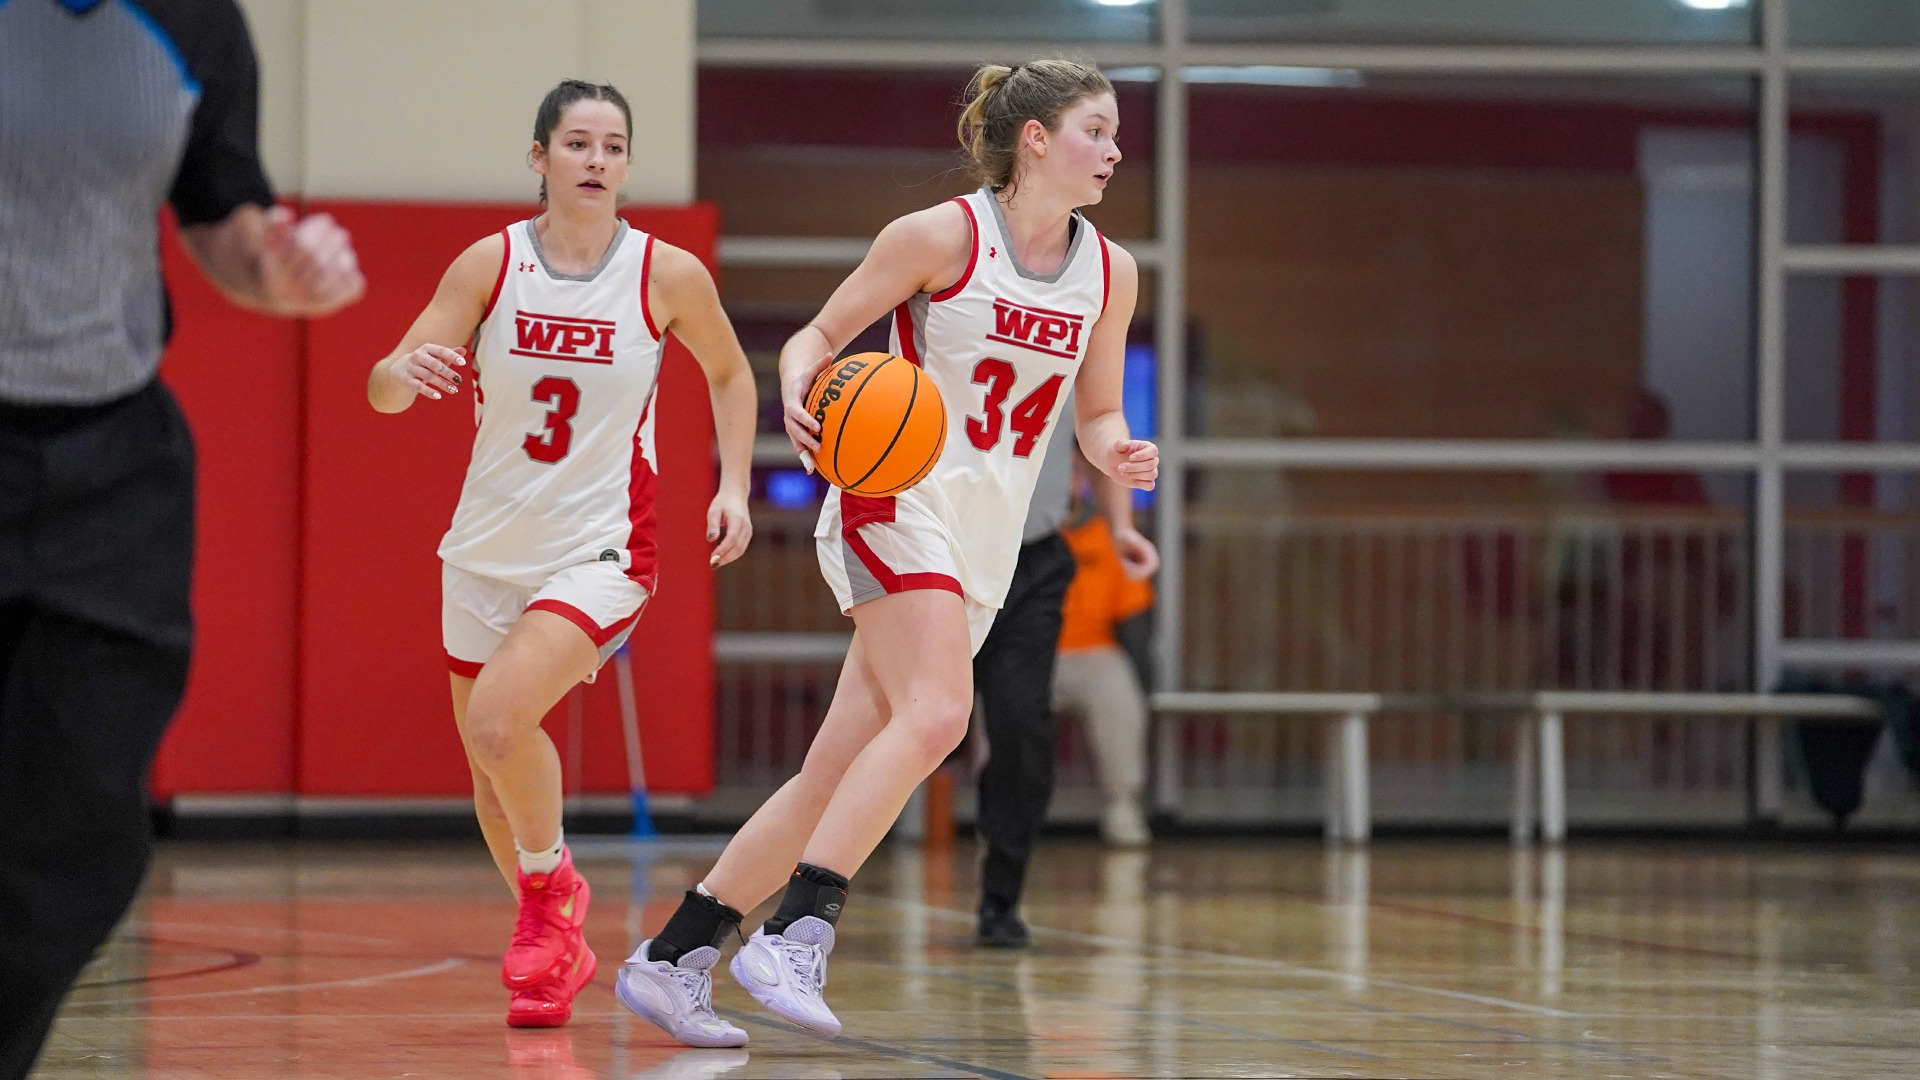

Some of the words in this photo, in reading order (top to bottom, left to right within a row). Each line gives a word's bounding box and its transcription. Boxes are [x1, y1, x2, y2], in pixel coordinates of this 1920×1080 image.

[515, 317, 616, 358] WPI
[993, 303, 1083, 352] WPI
[521, 375, 582, 465] 3
[965, 356, 1068, 459] 34
